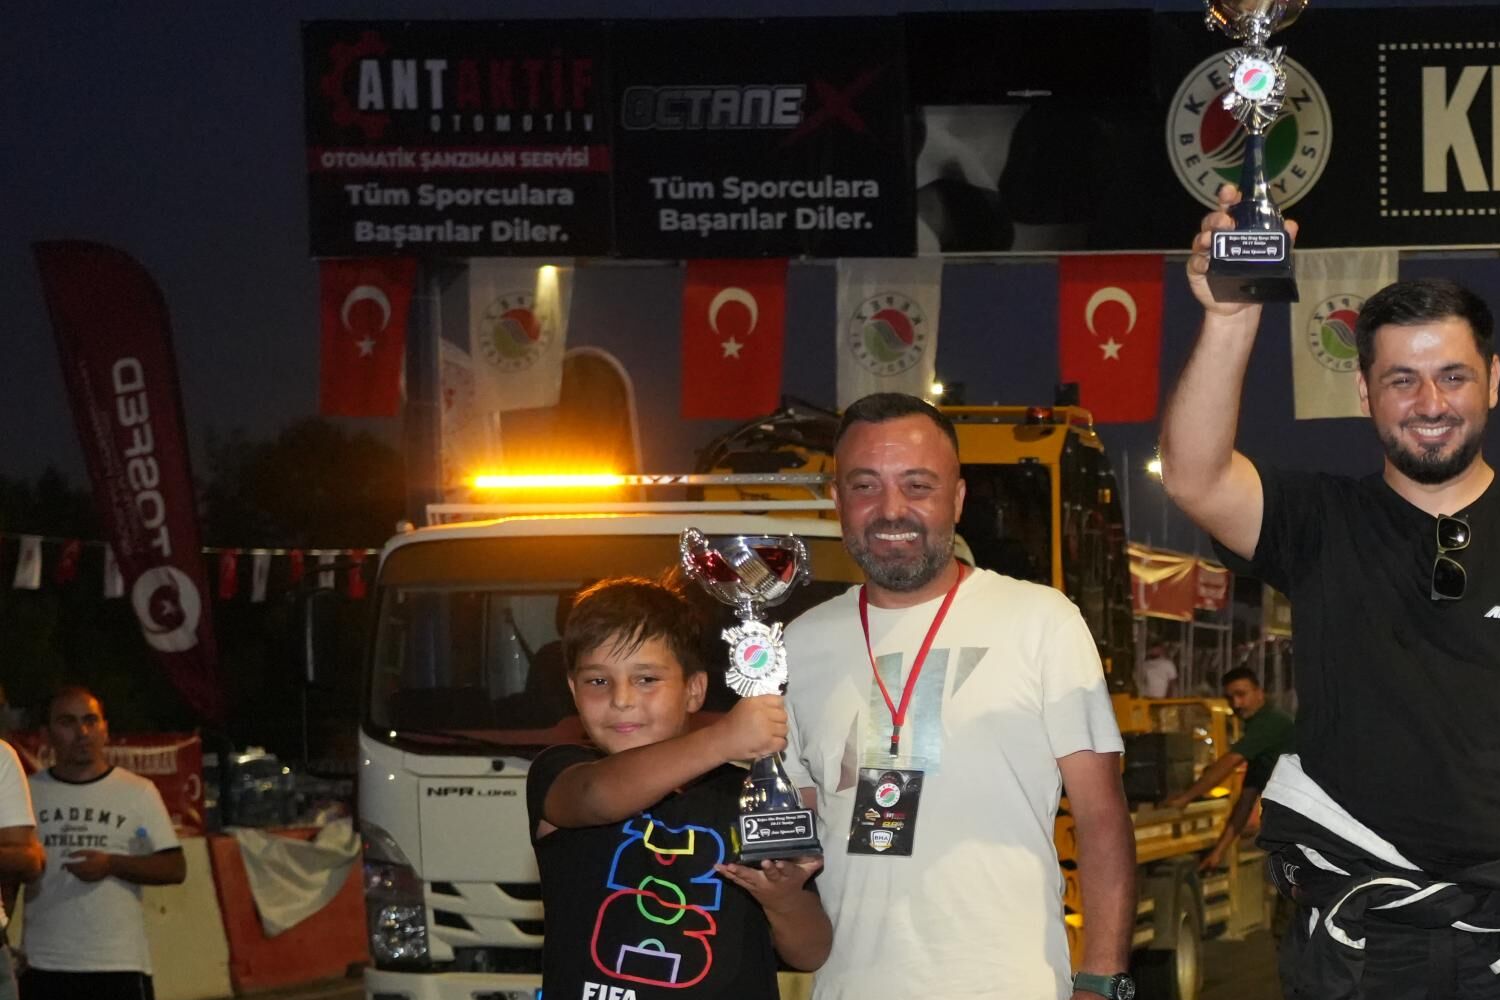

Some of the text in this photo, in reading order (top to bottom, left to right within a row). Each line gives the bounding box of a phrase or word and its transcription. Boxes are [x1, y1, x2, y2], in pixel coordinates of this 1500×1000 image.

[1185, 64, 1312, 115] KEZ
[321, 146, 589, 172] OTOMATİK ŞANZIMAN SERVİSİ
[344, 182, 575, 211] Tüm Sporculara
[649, 175, 880, 204] Tüm Sporculara
[354, 218, 569, 248] Başarılar Diler.
[659, 206, 872, 237] Başarılar Diler.
[427, 787, 473, 796] NPR
[39, 807, 127, 828] CADEMY
[44, 834, 108, 847] ATHLETIC
